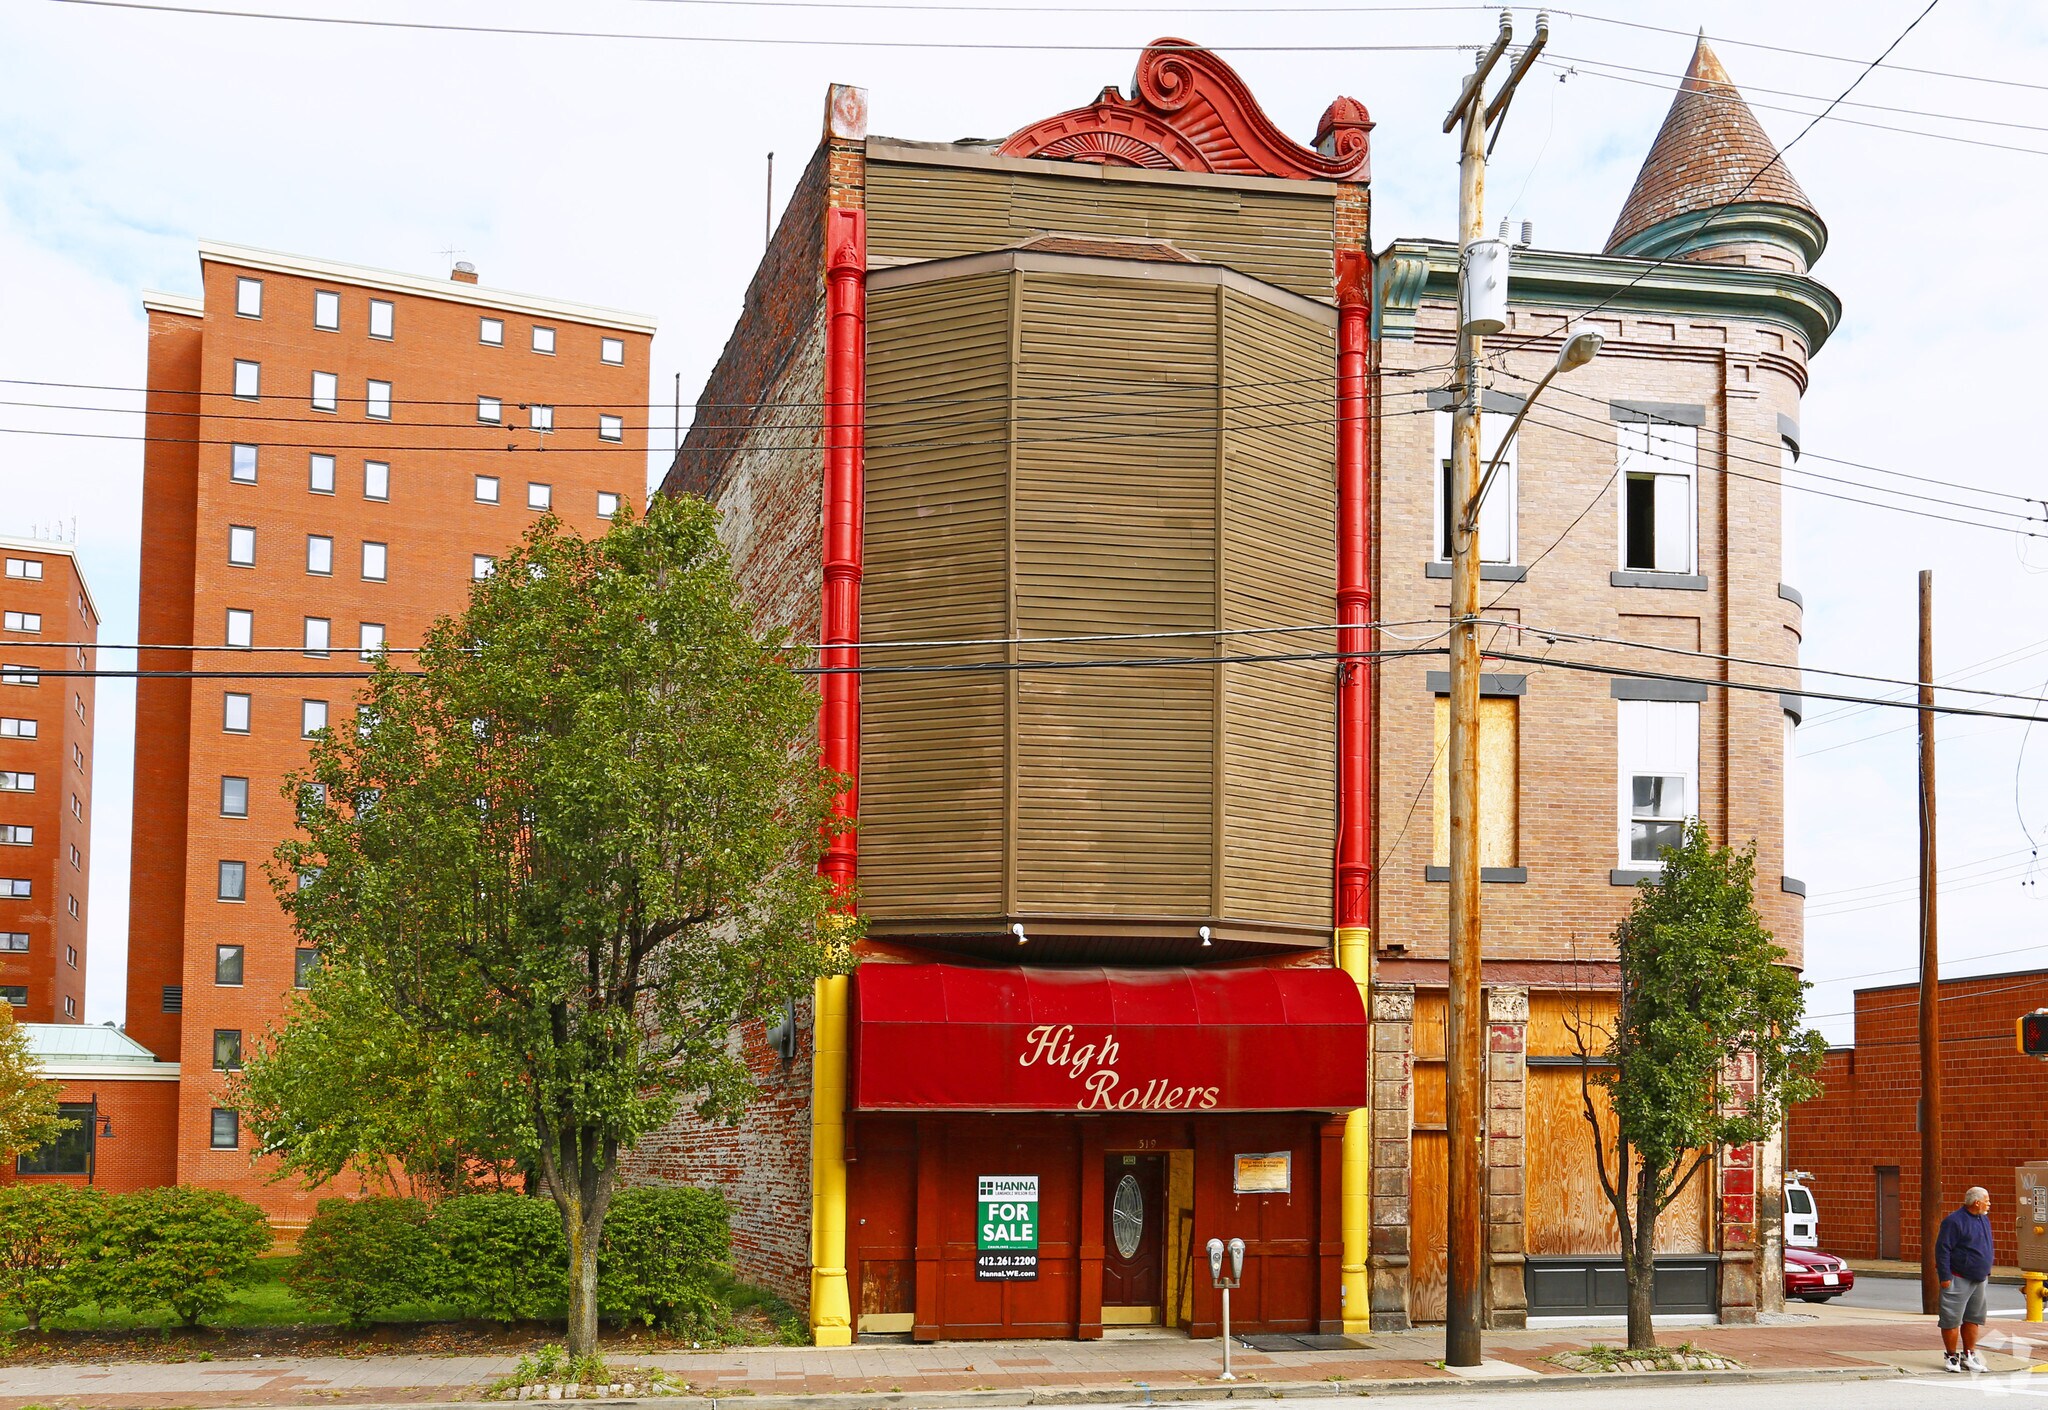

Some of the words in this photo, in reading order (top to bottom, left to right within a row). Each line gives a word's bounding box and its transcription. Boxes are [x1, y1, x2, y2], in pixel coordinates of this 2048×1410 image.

[1019, 1024, 1120, 1079] High
[1077, 1069, 1219, 1110] Rollers
[995, 1182, 1036, 1191] HANNA
[988, 1203, 1029, 1221] FOR
[983, 1224, 1033, 1242] SALE
[979, 1256, 1036, 1266] 412.261.2200
